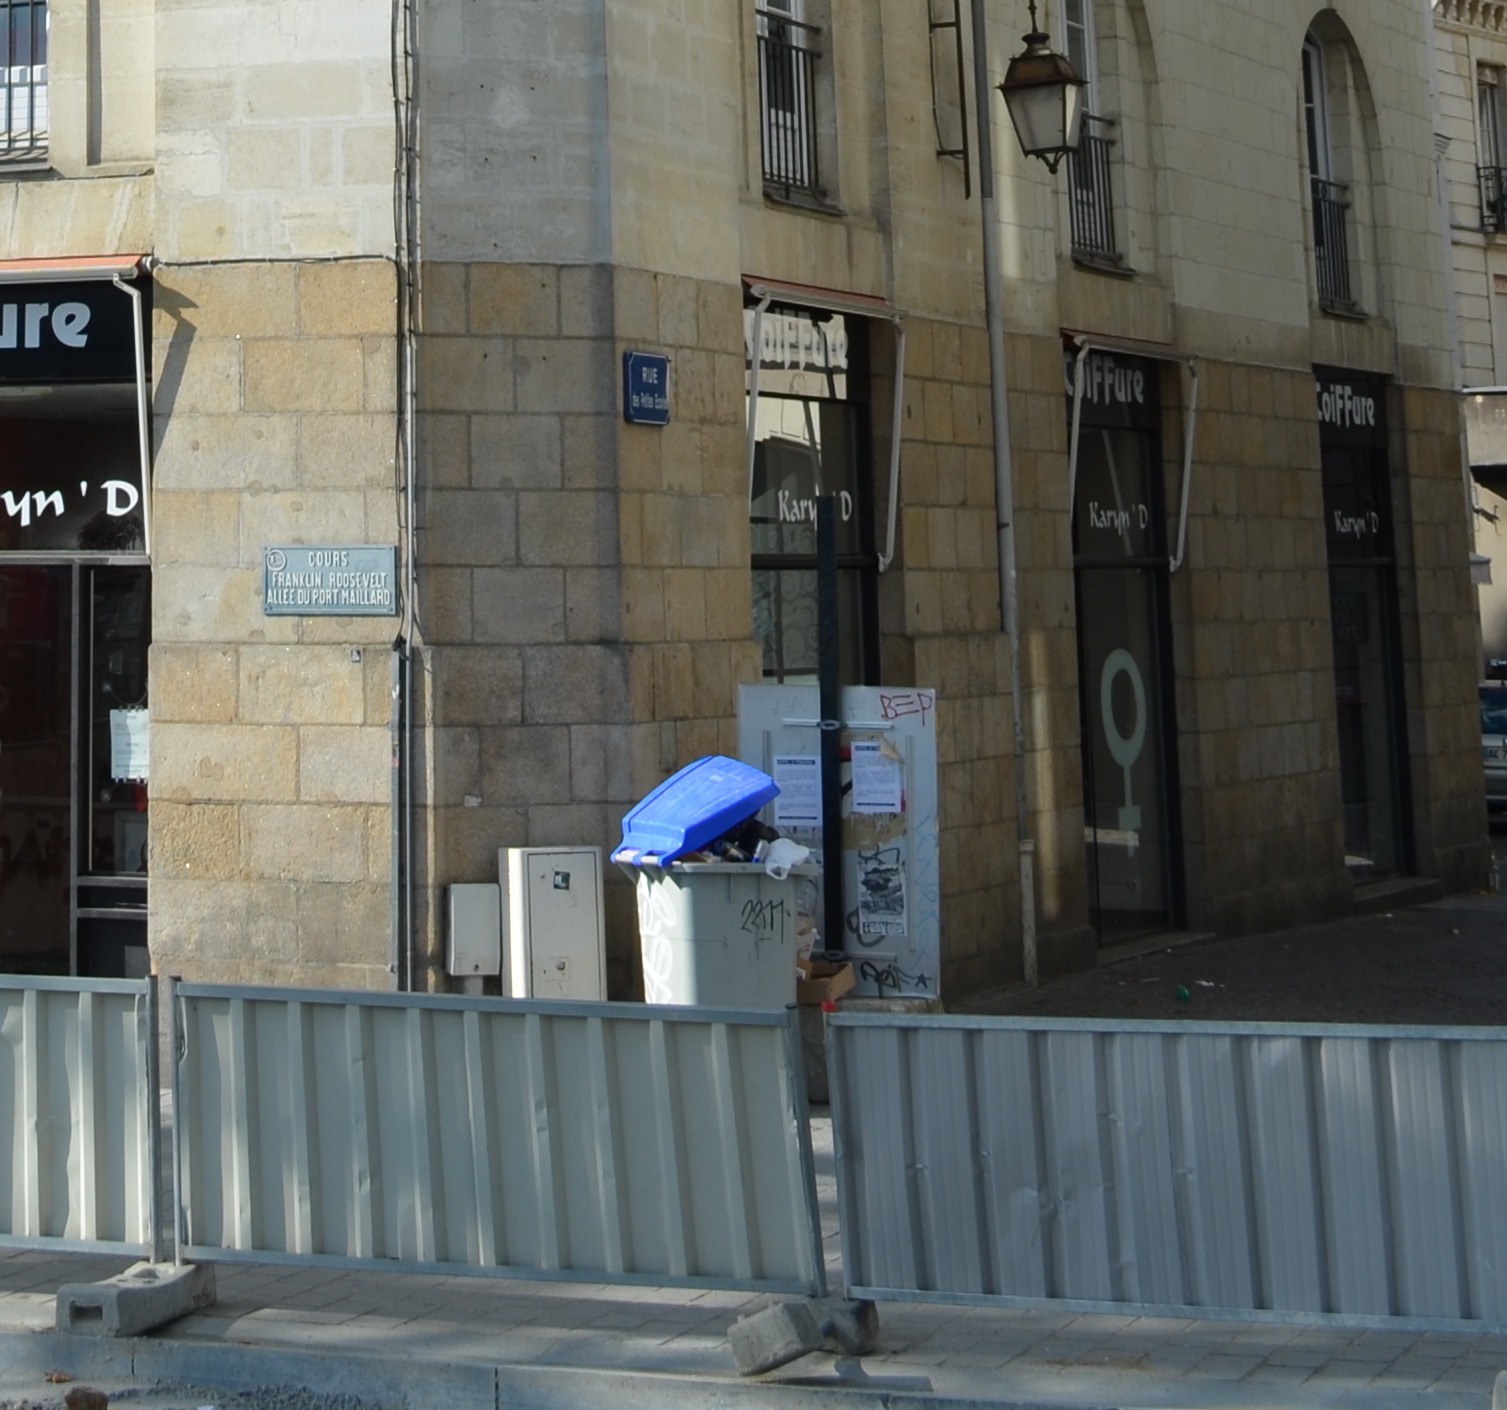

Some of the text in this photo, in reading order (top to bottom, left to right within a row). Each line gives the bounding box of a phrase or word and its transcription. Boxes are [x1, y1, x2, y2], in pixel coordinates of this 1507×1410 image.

[642, 366, 658, 384] RUE
[778, 490, 817, 531] Kary
[308, 551, 349, 567] COURS
[272, 572, 387, 588] FRANKLIN ROOSEVELT
[267, 589, 391, 606] ALLEE DU PORT MAILLARD
